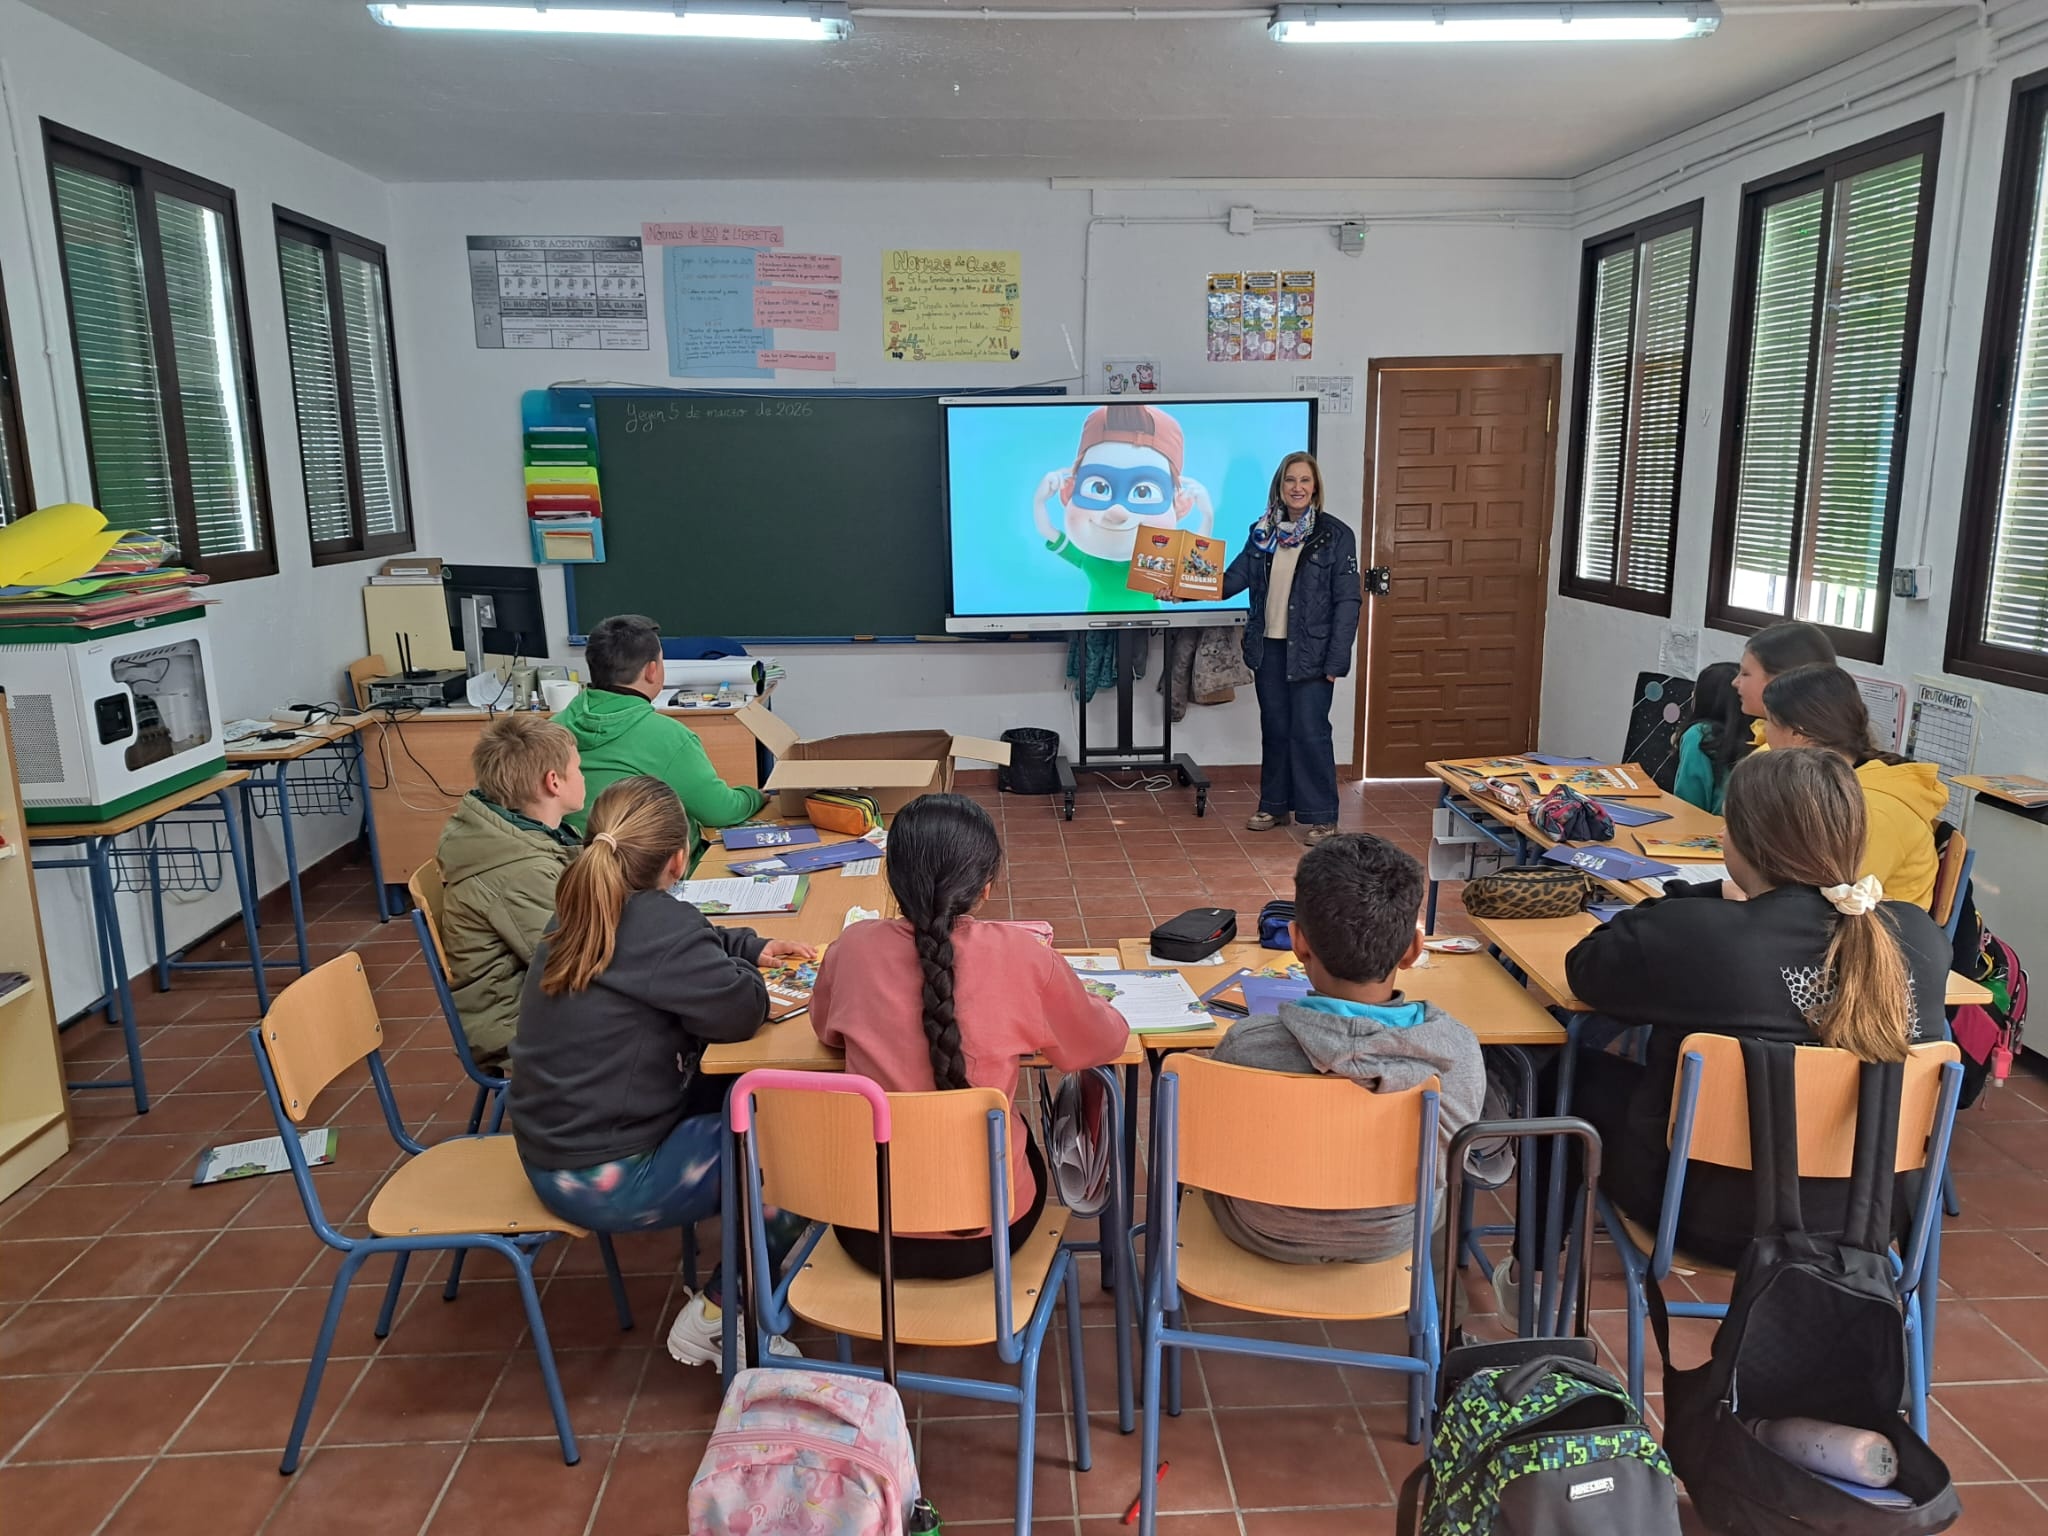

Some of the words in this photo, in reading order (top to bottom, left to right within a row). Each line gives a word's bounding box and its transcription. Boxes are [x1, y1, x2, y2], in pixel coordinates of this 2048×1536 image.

[688, 225, 698, 240] de
[533, 240, 546, 248] DE
[669, 401, 680, 421] 5
[686, 403, 700, 419] de
[755, 400, 772, 418] de
[775, 401, 814, 418] 2026
[746, 1495, 800, 1530] Barbie
